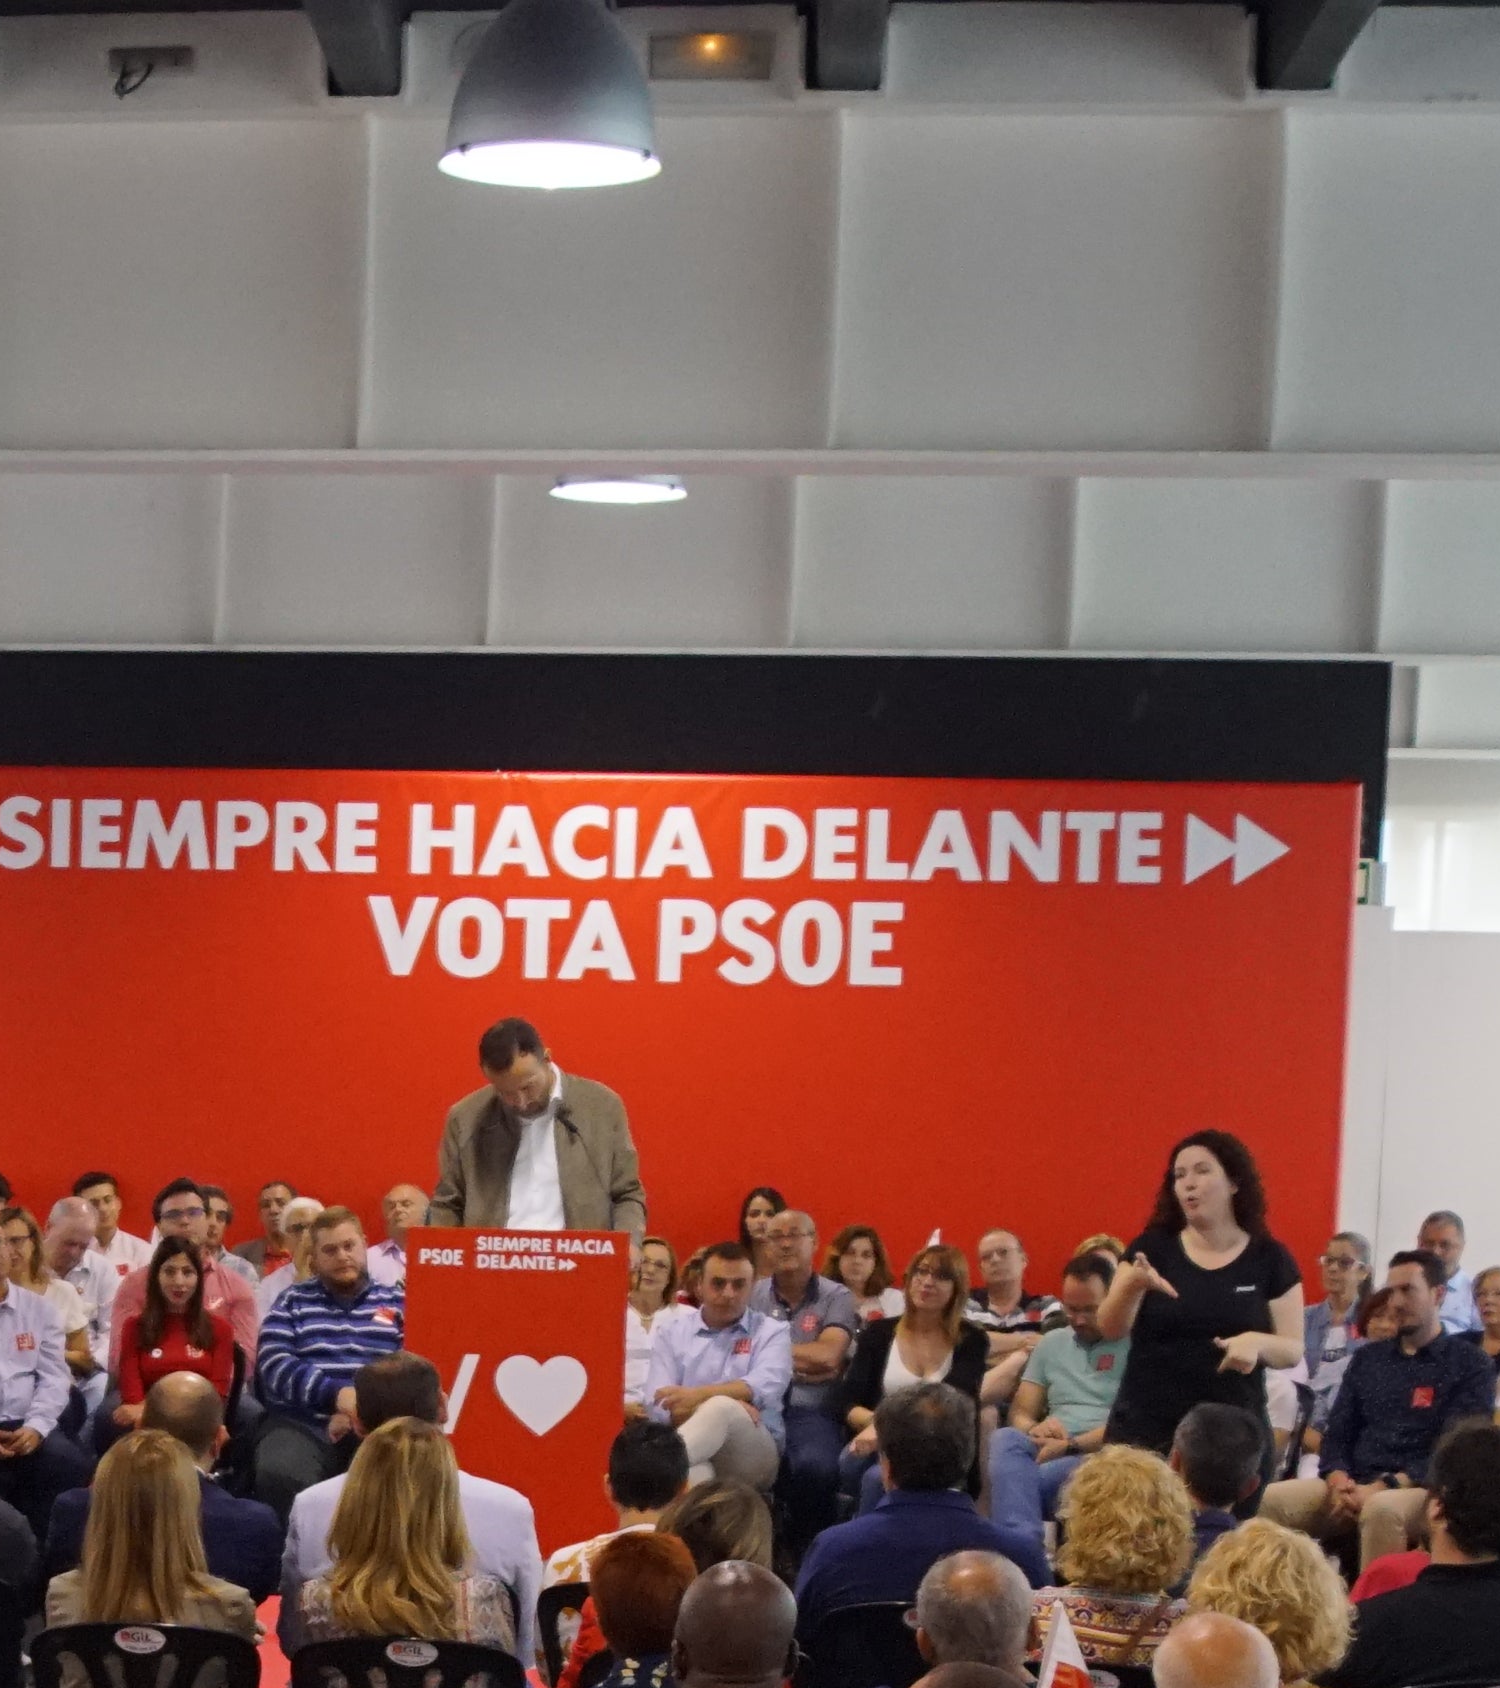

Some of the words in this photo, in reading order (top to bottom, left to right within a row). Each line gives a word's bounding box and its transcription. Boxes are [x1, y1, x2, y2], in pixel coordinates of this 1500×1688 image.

[409, 803, 712, 880] HACIA
[741, 808, 1162, 885] DELANTE
[367, 895, 636, 981] VOTA
[656, 898, 903, 987] PSOE
[476, 1236, 551, 1253] SIEMPRE
[556, 1238, 615, 1255] HACIA
[419, 1248, 463, 1266] PSOE
[476, 1253, 556, 1271] DELANTE
